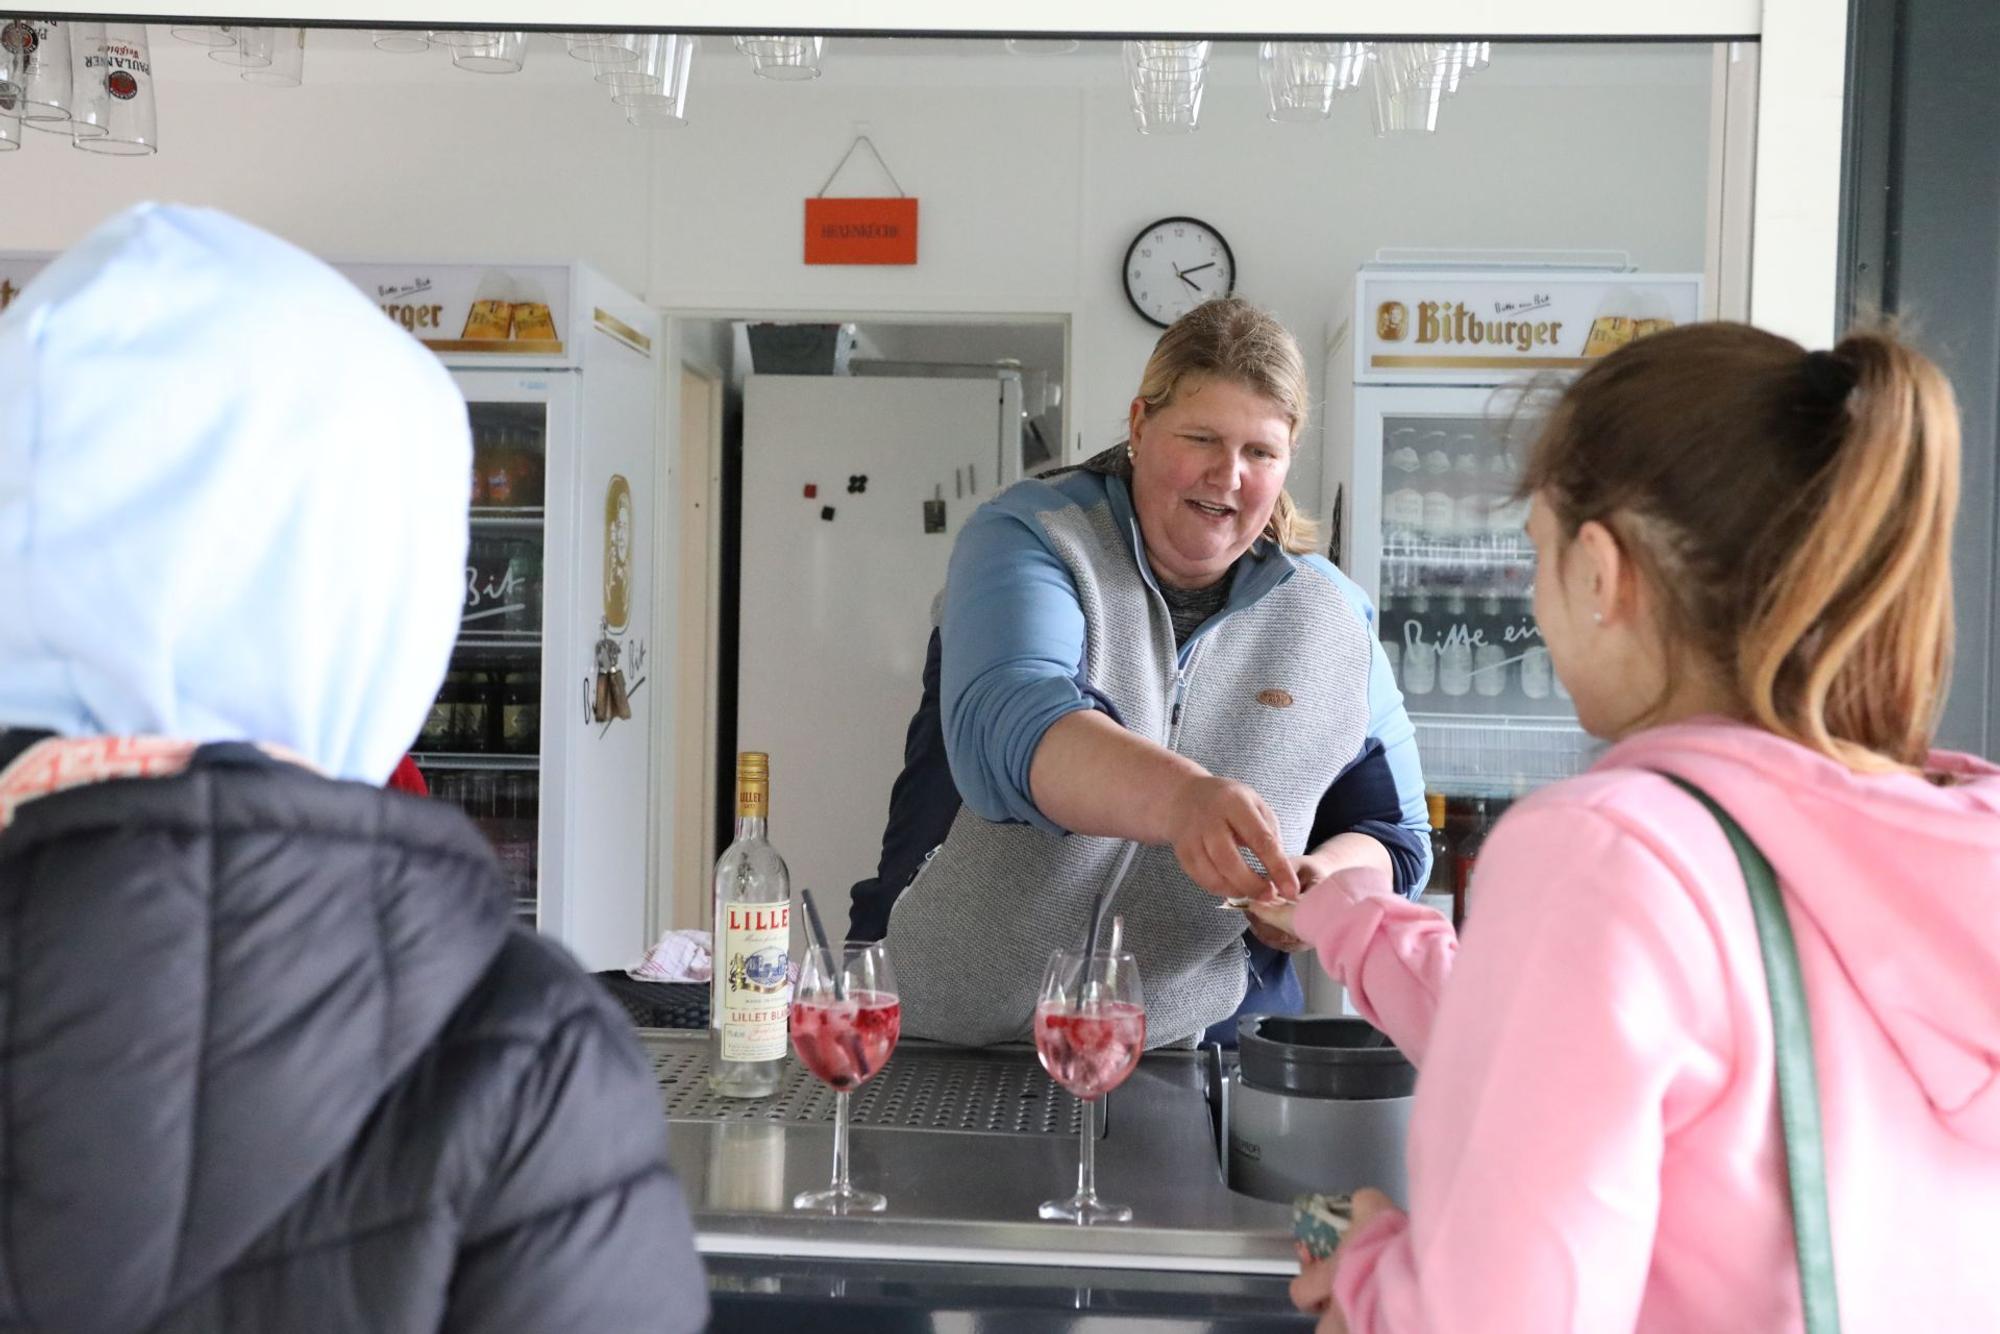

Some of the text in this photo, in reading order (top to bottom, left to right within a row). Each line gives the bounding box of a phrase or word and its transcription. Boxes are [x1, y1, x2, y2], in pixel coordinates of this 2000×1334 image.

[1174, 228, 1184, 238] 12
[1141, 248, 1152, 258] 10
[1414, 300, 1563, 352] Bitburger
[1403, 619, 1489, 665] Bitte
[730, 908, 791, 930] LILLE
[732, 1012, 767, 1022] LILLET
